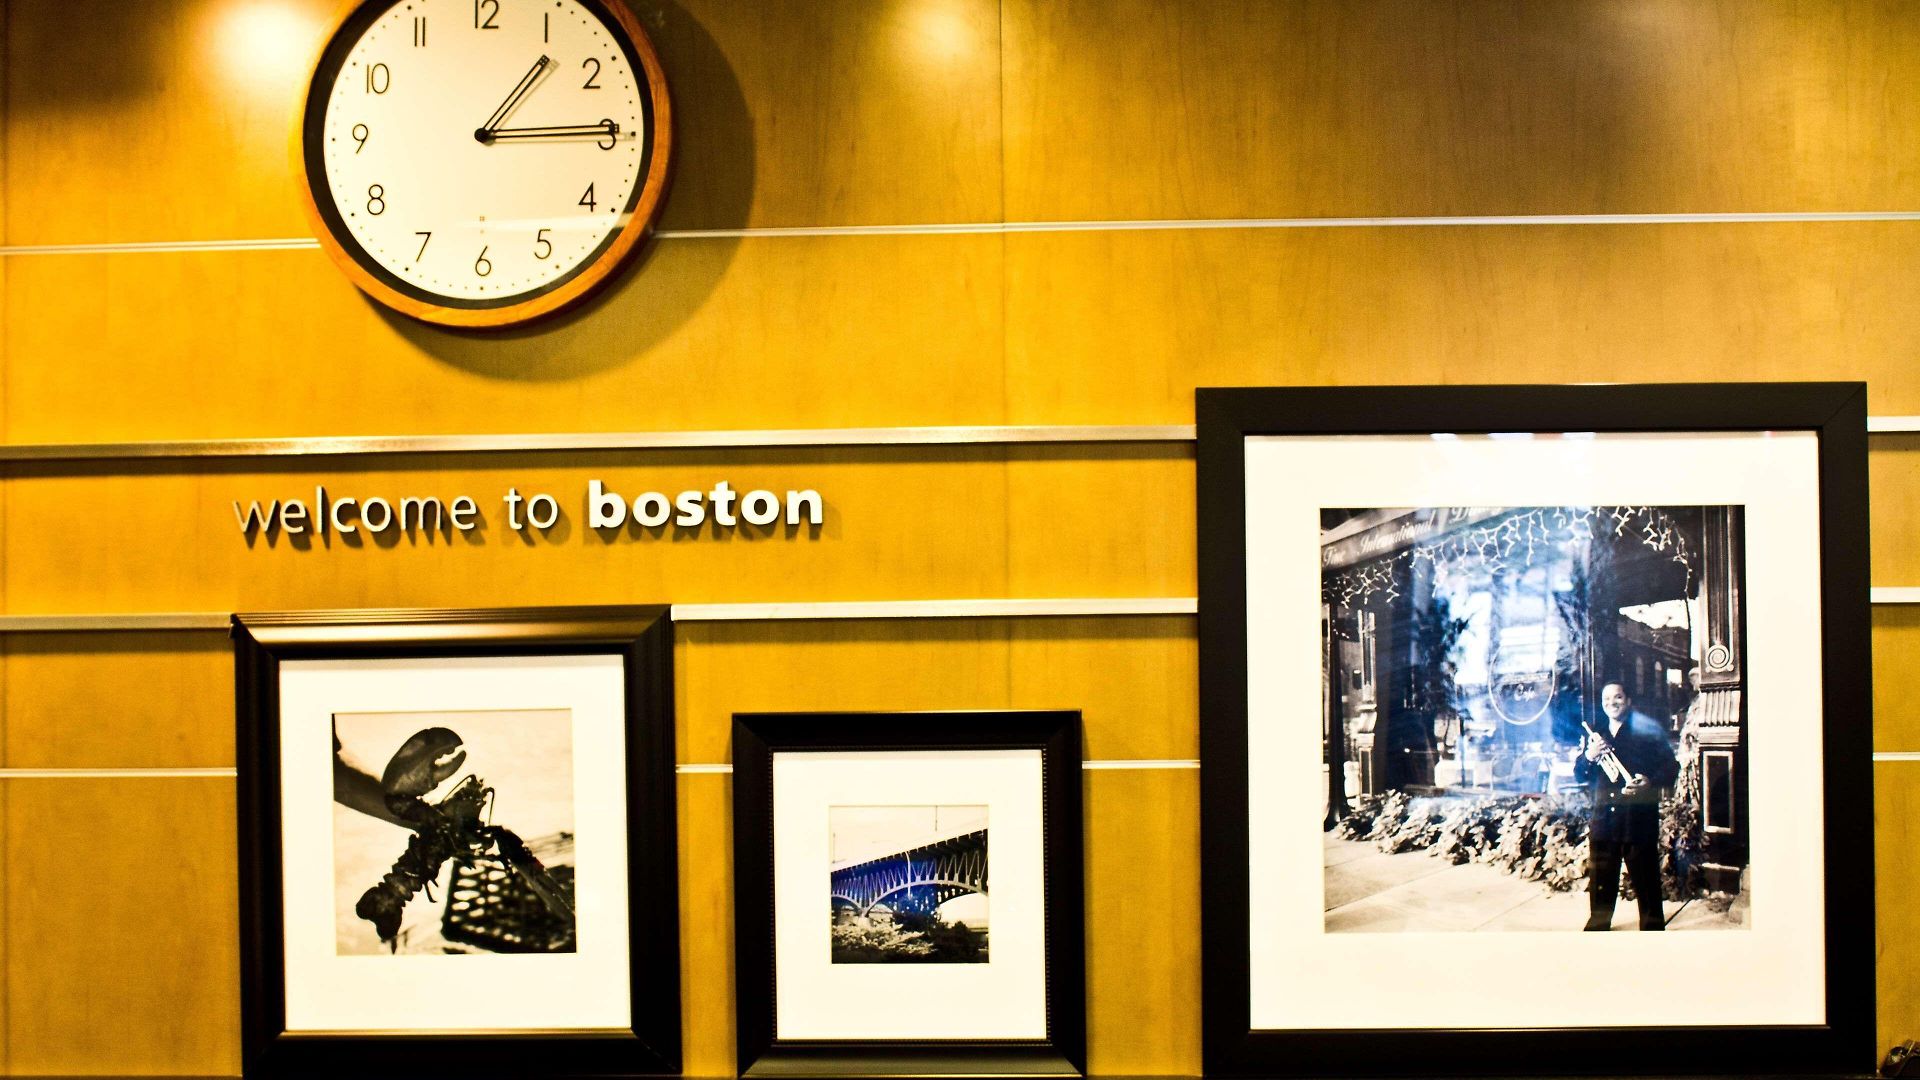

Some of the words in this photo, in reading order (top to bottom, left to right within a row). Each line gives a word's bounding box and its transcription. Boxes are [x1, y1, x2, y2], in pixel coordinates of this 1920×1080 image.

[475, 0, 499, 29] 12
[544, 12, 549, 43] 1
[414, 17, 426, 47] 11
[366, 63, 390, 94] 10
[582, 58, 601, 89] 2
[352, 123, 369, 154] 9
[597, 118, 616, 150] 3
[367, 184, 385, 215] 8
[578, 182, 597, 212] 4
[415, 232, 432, 262] 7
[534, 229, 552, 260] 5
[475, 246, 491, 277] 6
[233, 485, 477, 534] welcome
[504, 487, 558, 530] to
[589, 480, 823, 528] boston
